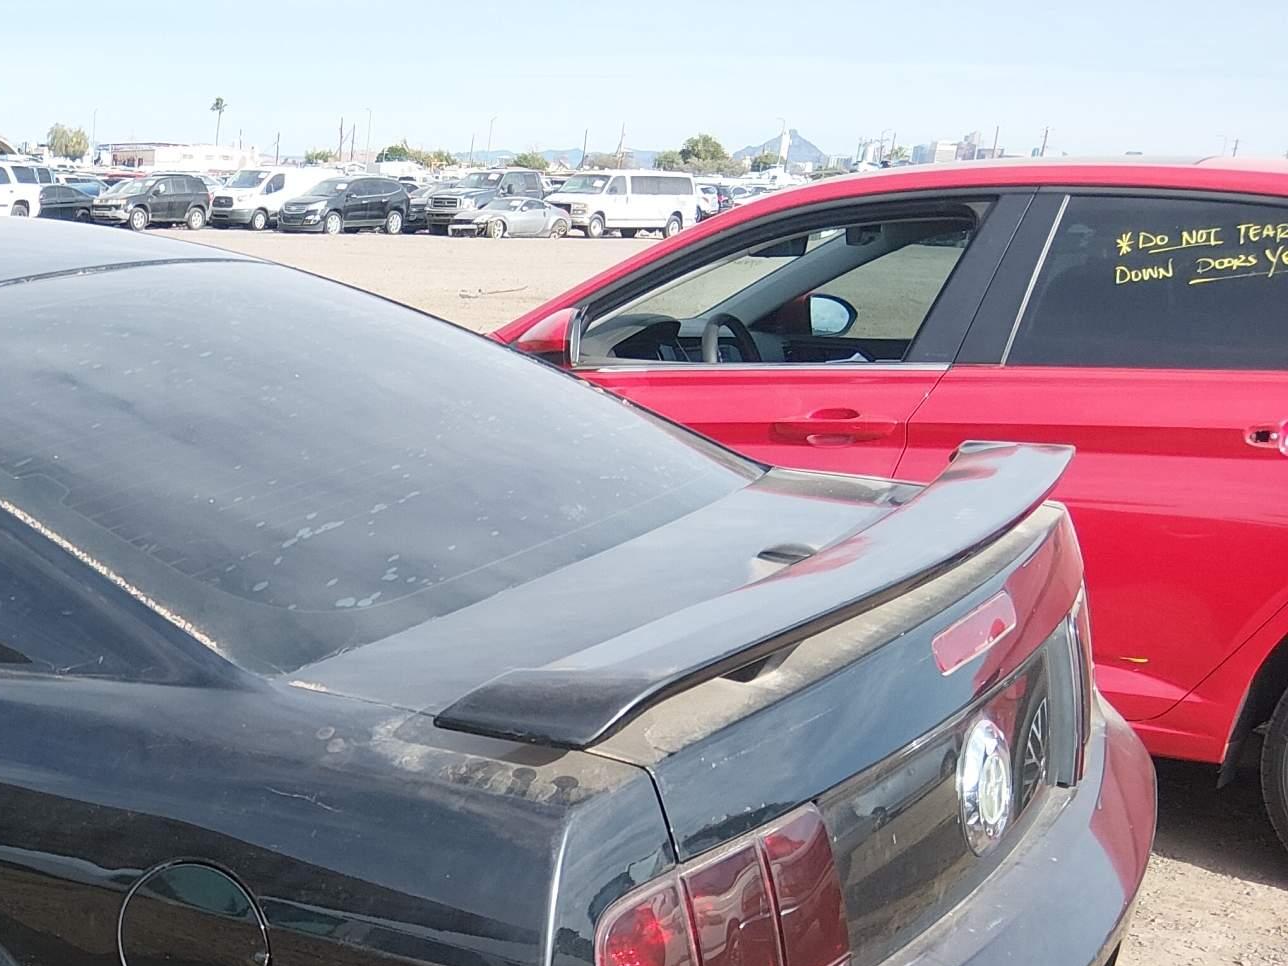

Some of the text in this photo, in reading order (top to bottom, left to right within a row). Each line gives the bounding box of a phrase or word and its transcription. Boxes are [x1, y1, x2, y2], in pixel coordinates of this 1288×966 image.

[1181, 227, 1225, 247] NOT
[1237, 223, 1288, 245] TEAR
[1115, 258, 1174, 285] DOWN
